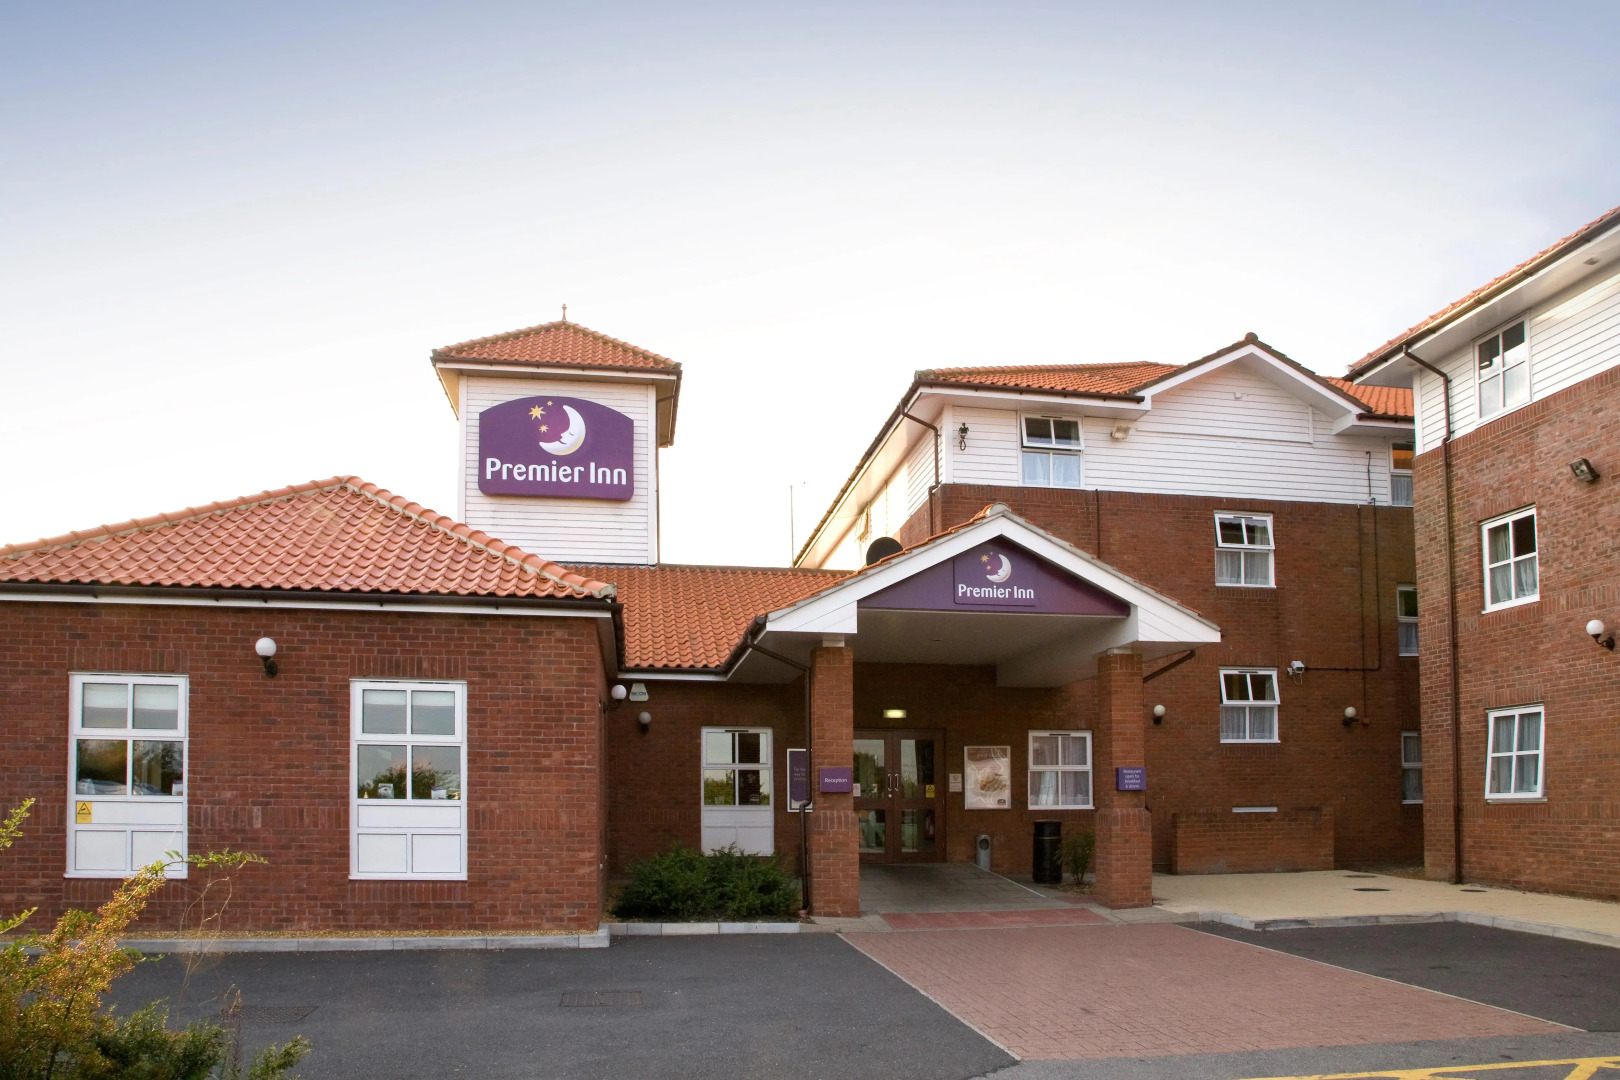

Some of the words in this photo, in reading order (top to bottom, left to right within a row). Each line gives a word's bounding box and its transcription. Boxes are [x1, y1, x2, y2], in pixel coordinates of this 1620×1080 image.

[485, 457, 584, 483] Premier
[589, 462, 627, 485] Inn
[958, 583, 1011, 598] Premier
[1013, 586, 1034, 599] Inn
